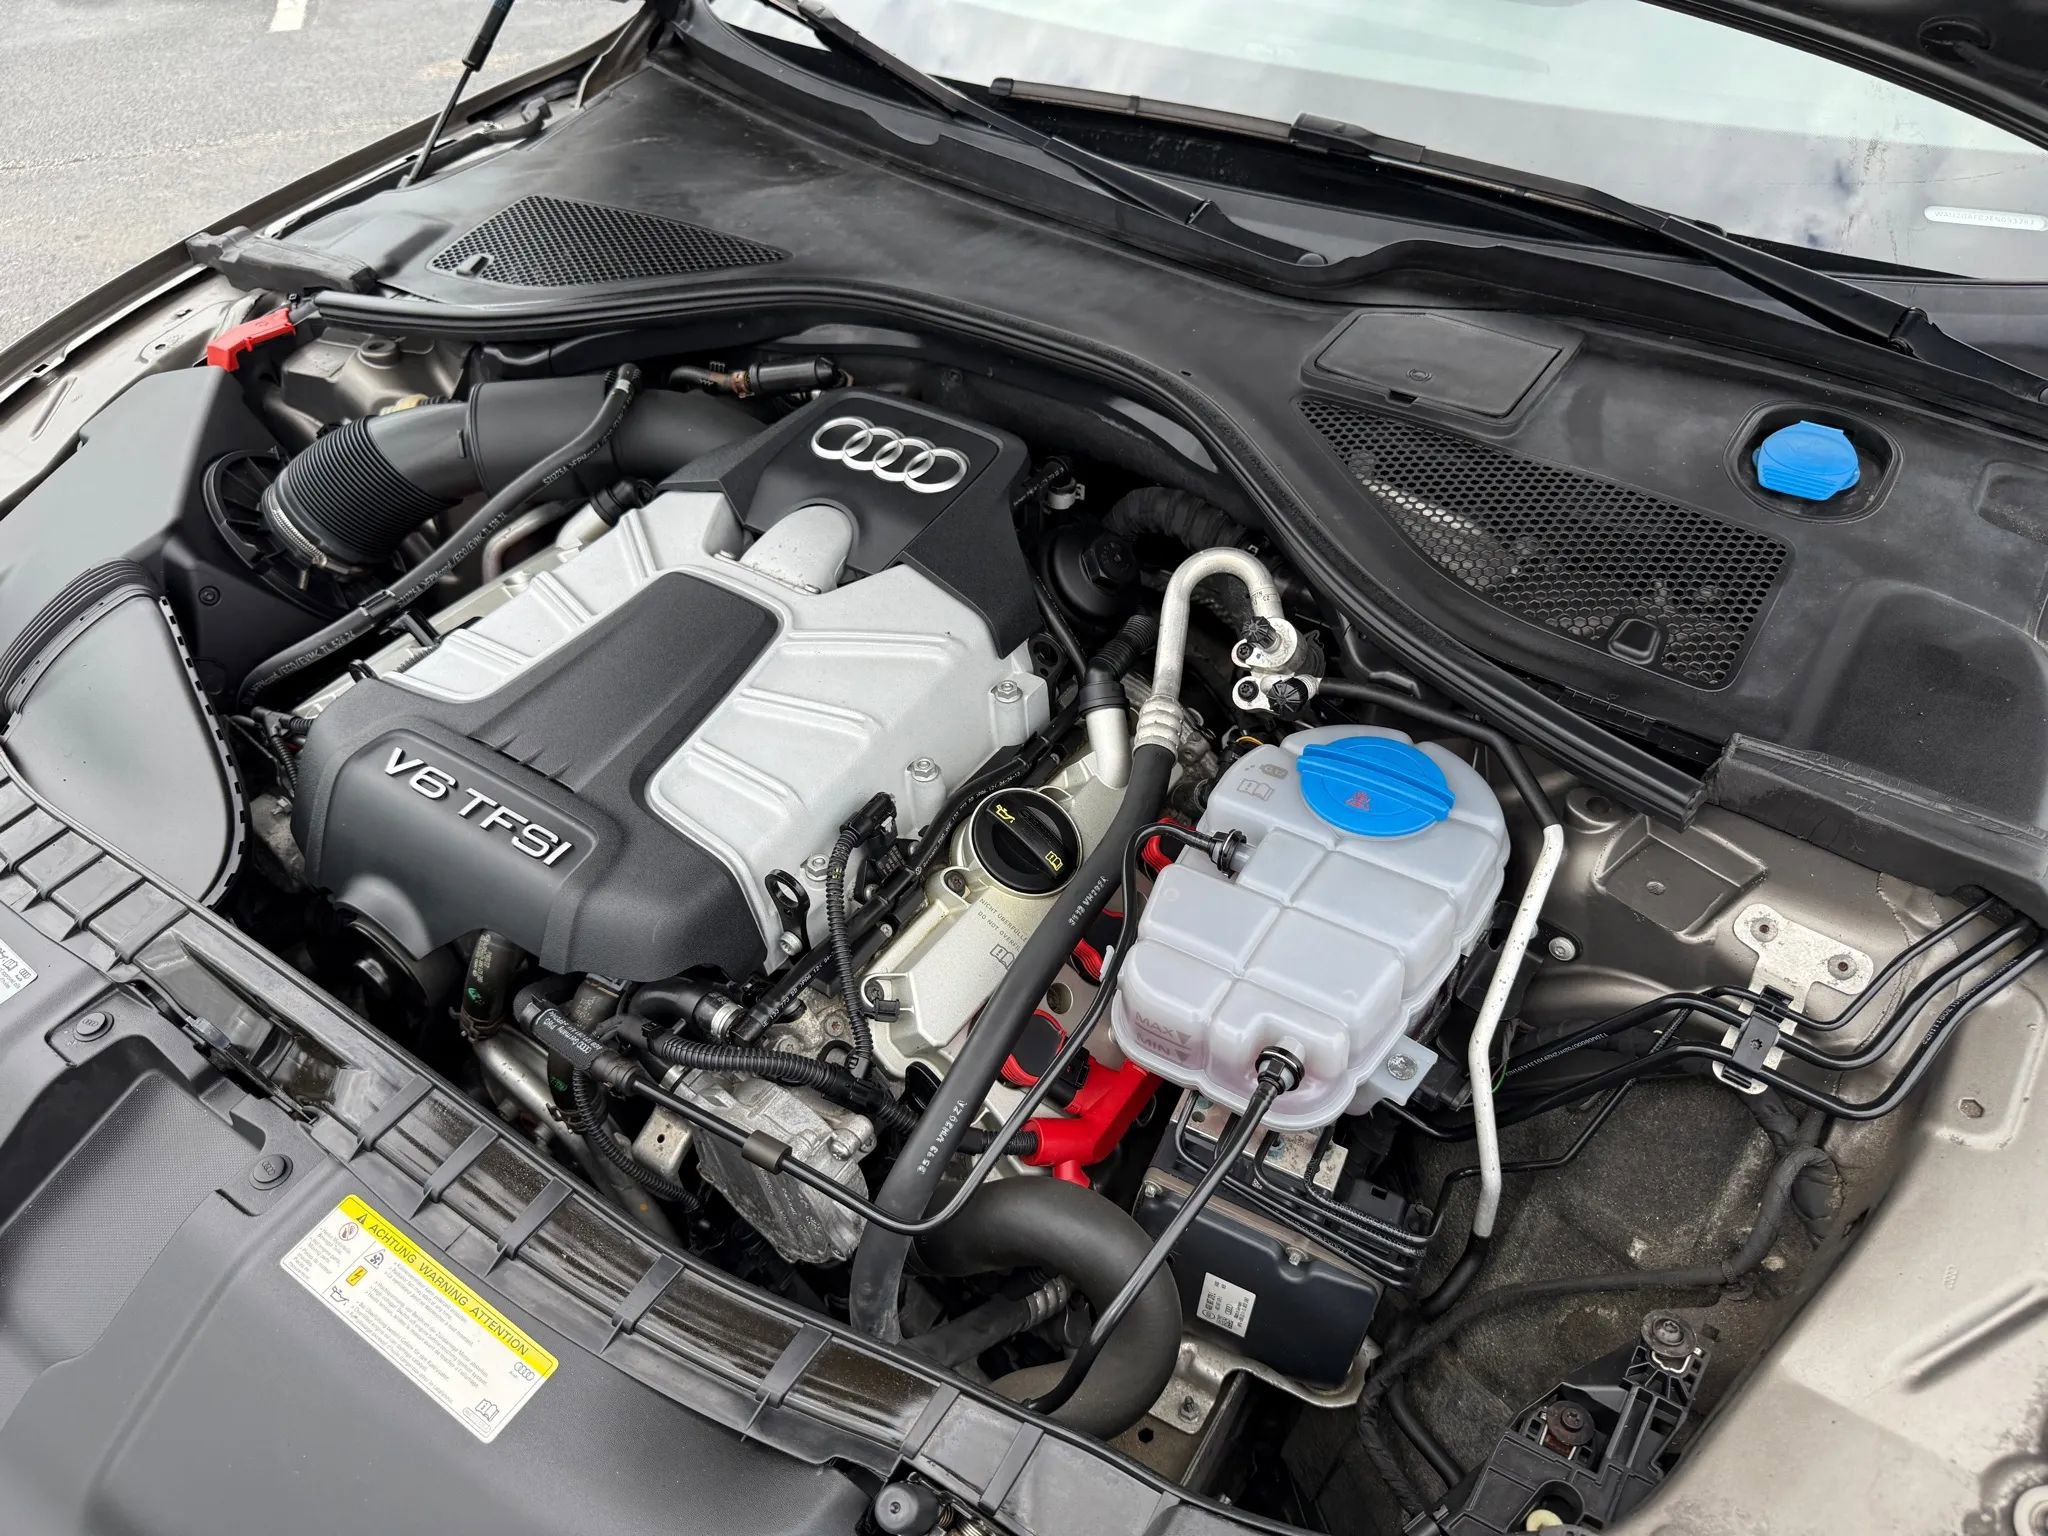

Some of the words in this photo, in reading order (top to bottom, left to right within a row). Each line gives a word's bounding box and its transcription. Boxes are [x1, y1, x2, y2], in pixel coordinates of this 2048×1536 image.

[384, 746, 456, 800] V6
[457, 787, 573, 867] TFSI
[978, 911, 987, 920] DO
[987, 919, 1000, 931] NOT
[999, 930, 1022, 952] OVERFIL
[979, 898, 998, 914] NICHT
[997, 911, 1028, 942] ÜBERFÜLLE
[1135, 1012, 1175, 1038] MAX
[1136, 1032, 1170, 1055] MIN
[367, 1222, 418, 1264] ACHTUNG
[416, 1262, 470, 1307] WARNING
[468, 1305, 529, 1356] ATTENTION
